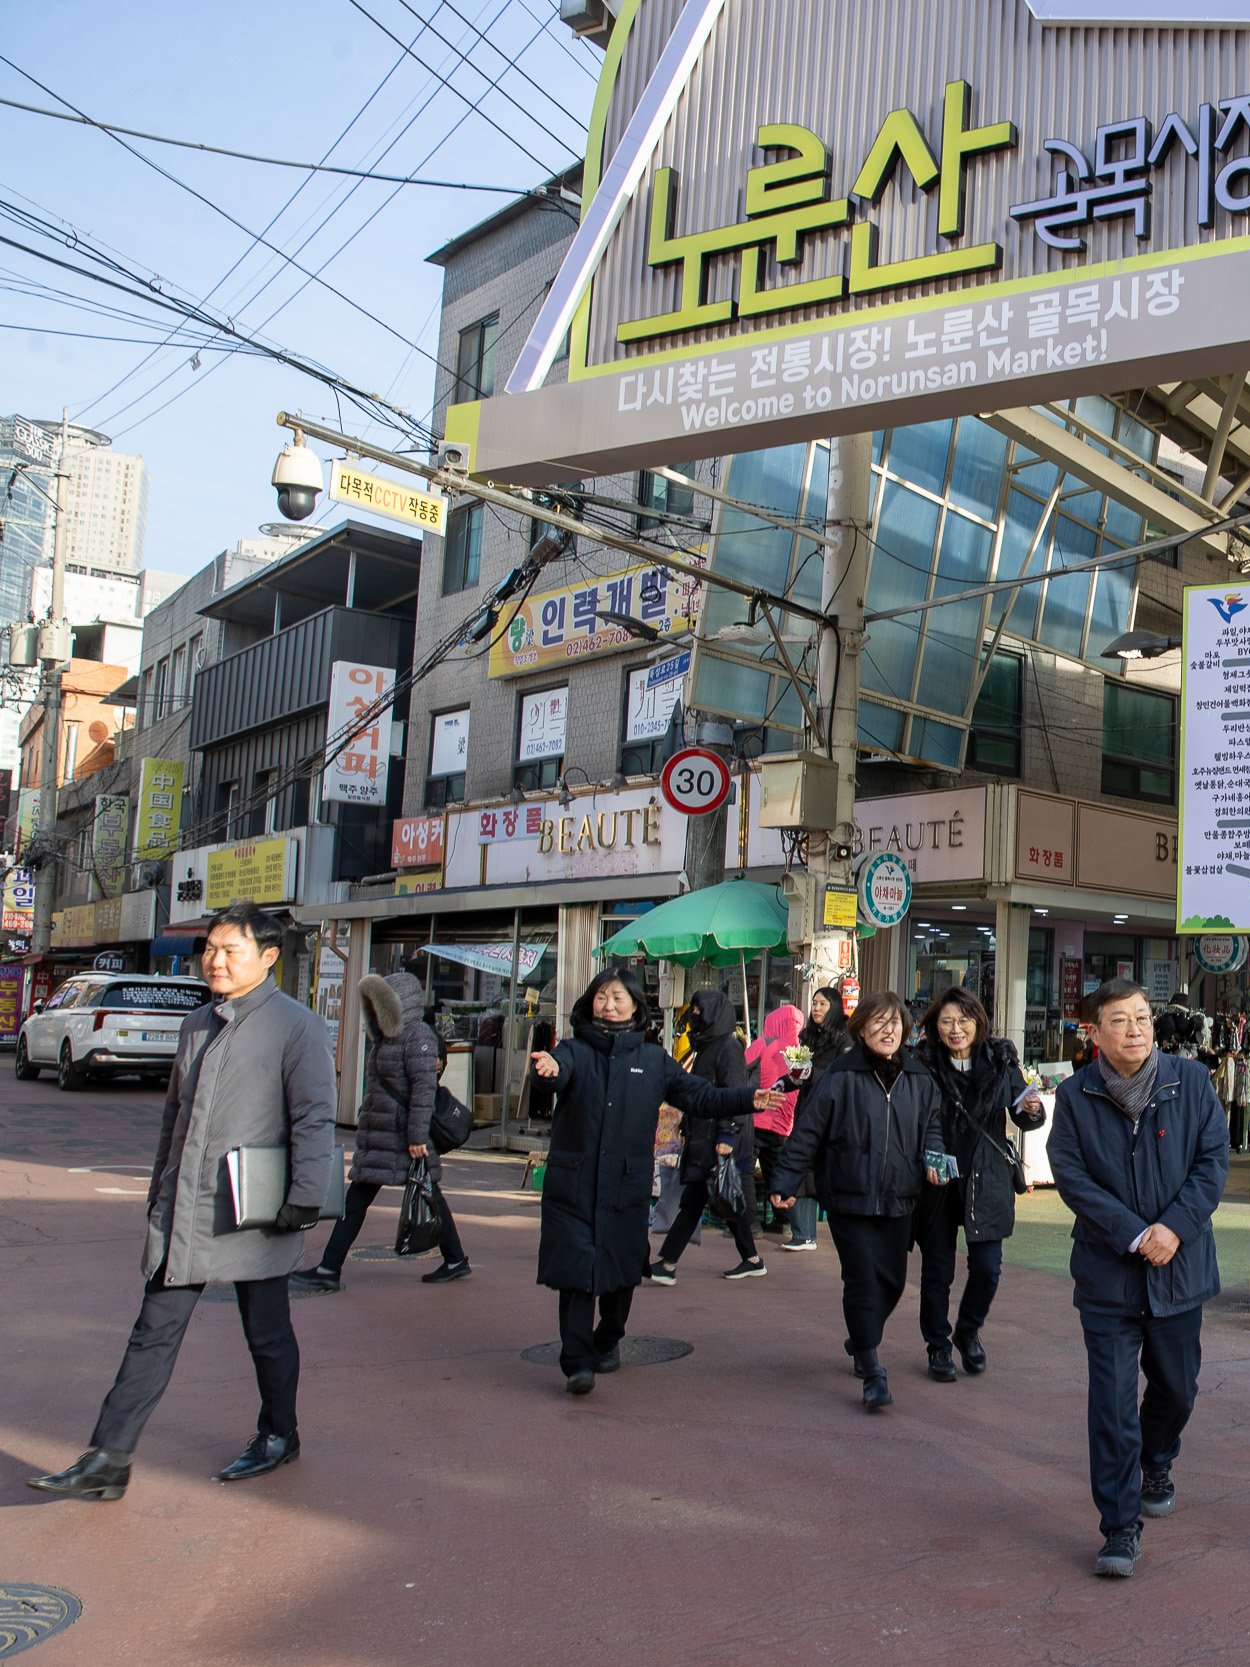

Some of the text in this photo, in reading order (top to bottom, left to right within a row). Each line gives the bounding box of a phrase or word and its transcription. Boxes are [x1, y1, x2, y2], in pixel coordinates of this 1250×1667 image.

[617, 80, 1017, 343] 노룬산
[618, 269, 1184, 412] 다시찾는 전통시장! 노룬산 골목시장
[681, 329, 1108, 431] Welcome to Norunsan Market!
[541, 565, 669, 647] 인력개발
[510, 617, 526, 653] 량
[658, 617, 671, 633] 2층
[1190, 659, 1220, 670] 숯불갈비
[1204, 651, 1221, 659] 마포
[527, 739, 562, 755] 02)462-7082
[339, 784, 378, 796] 맥주 양주
[676, 768, 714, 796] 30
[480, 807, 542, 838] 화장품
[538, 796, 662, 853] BEAUTÉ
[1204, 829, 1250, 840] 만물종합주방
[98, 814, 123, 890] 부동산
[1029, 847, 1064, 869] 화장품
[1217, 851, 1250, 861] 야채,마늘
[1185, 865, 1224, 875] 불꽃삼겹살
[98, 957, 123, 969] 커피
